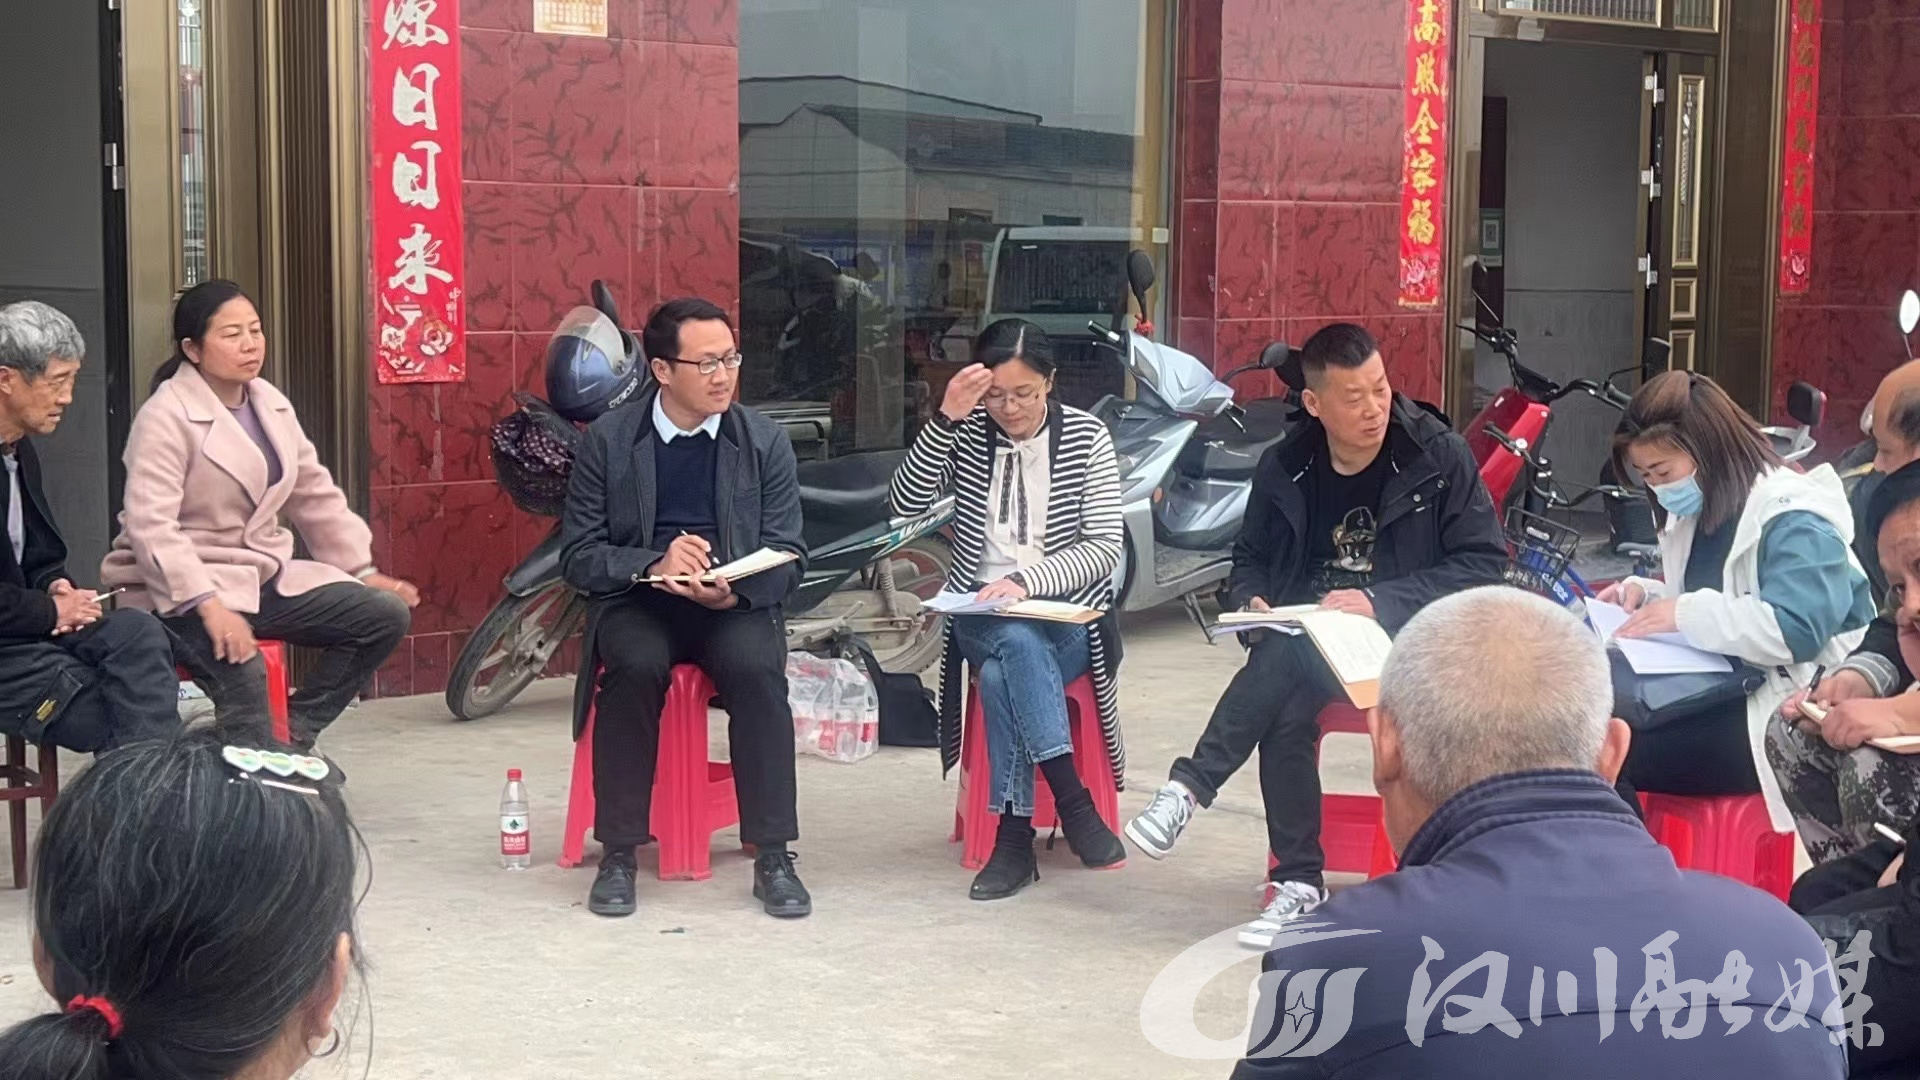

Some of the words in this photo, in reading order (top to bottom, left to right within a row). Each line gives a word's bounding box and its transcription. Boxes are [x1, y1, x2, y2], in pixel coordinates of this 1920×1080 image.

[1407, 0, 1441, 245] 高照全家福
